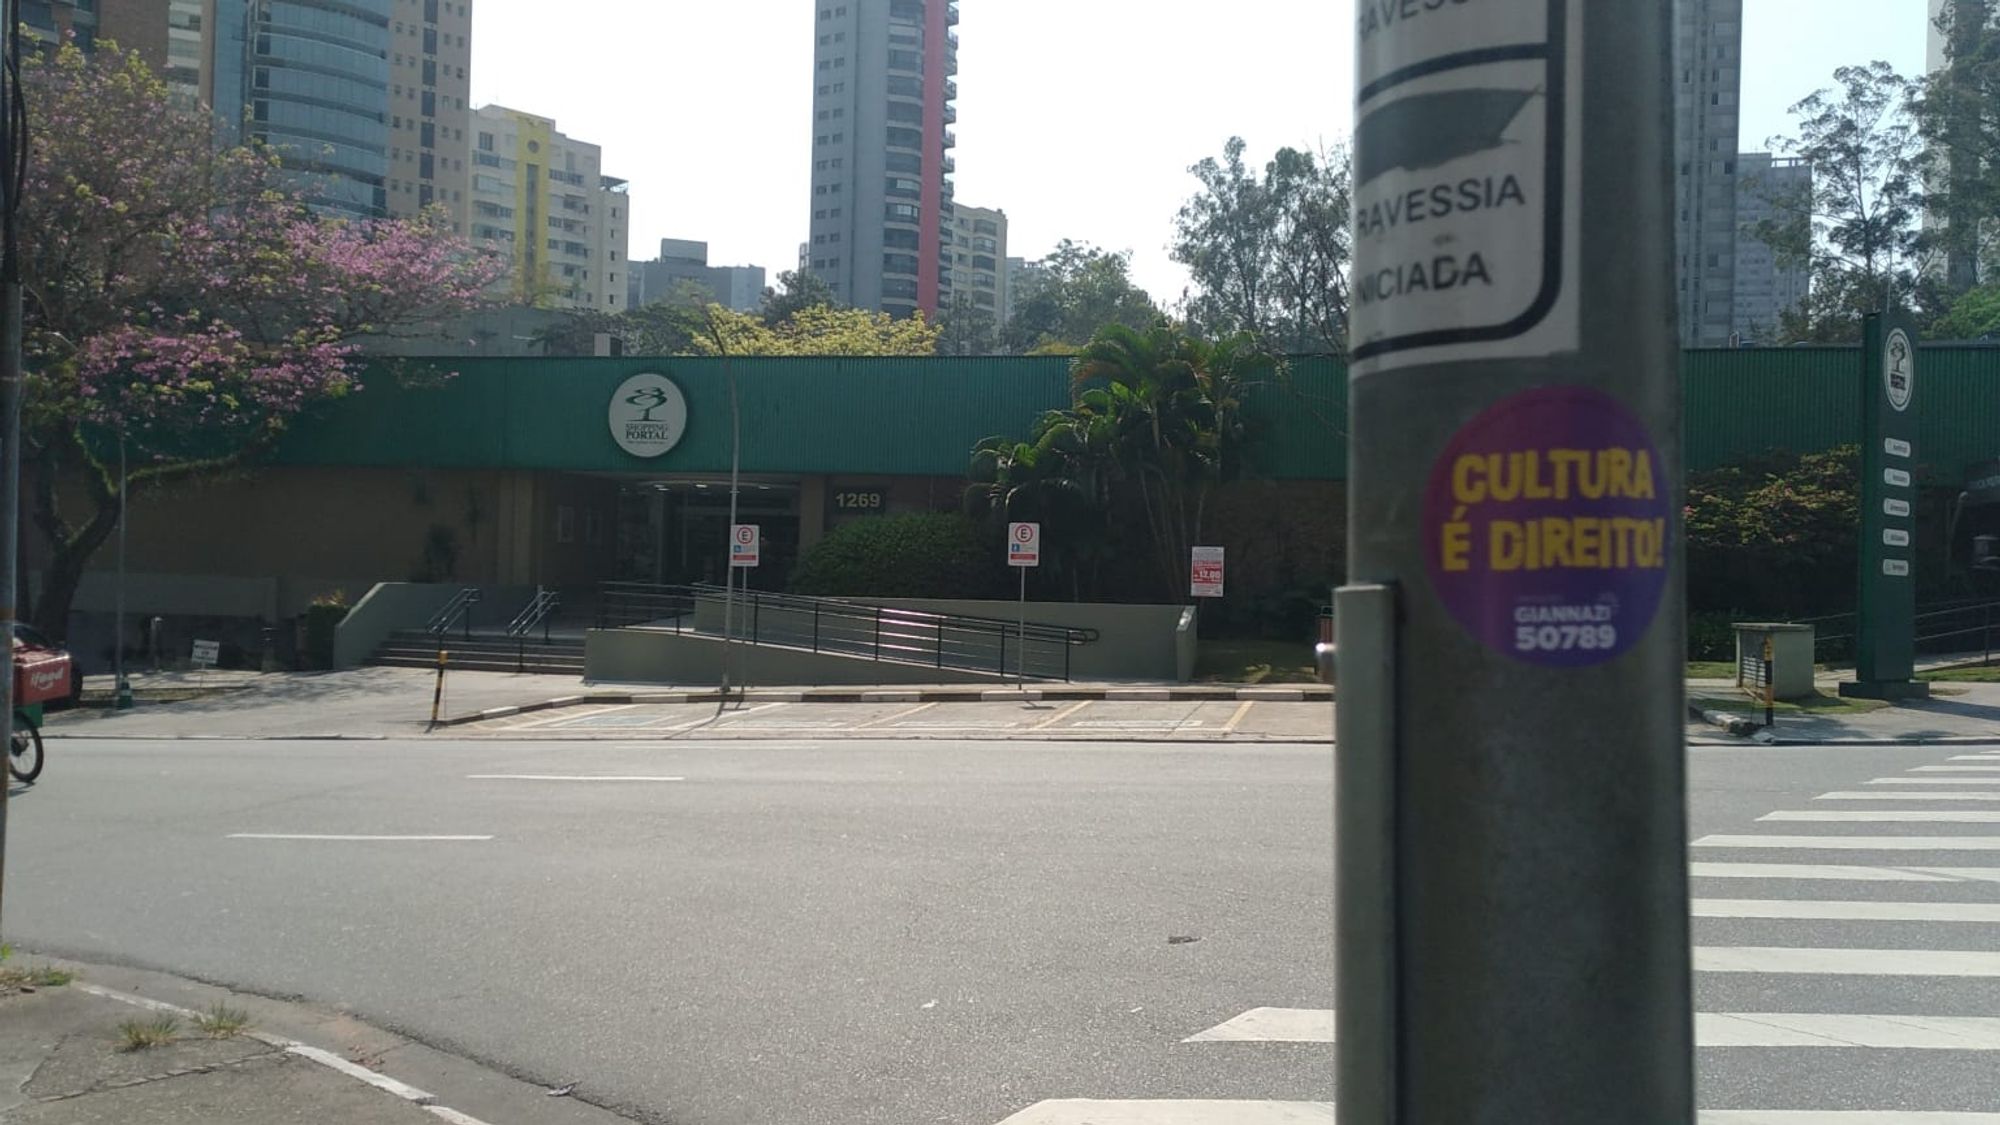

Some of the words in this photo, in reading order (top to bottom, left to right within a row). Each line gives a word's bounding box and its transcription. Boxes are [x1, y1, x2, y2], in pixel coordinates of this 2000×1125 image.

[625, 431, 668, 440] PORTAL
[1453, 447, 1656, 503] CULTURA
[836, 493, 881, 508] 1269
[741, 531, 748, 541] E
[1020, 528, 1028, 539] E
[1442, 505, 1472, 571] É
[1489, 516, 1665, 571] DIREITO!
[1513, 605, 1612, 623] GIANNAZI
[1515, 625, 1617, 650] 50789
